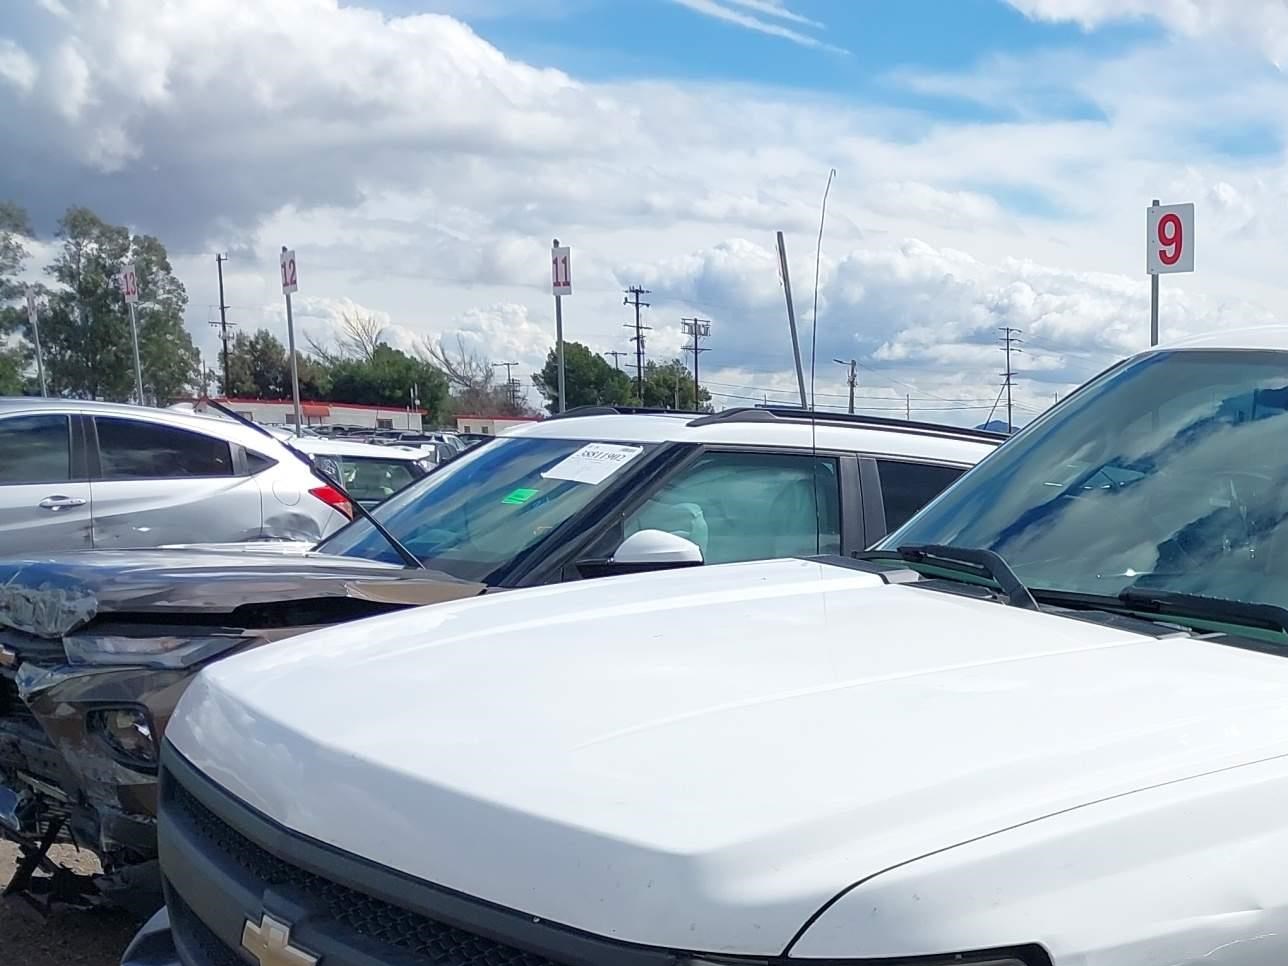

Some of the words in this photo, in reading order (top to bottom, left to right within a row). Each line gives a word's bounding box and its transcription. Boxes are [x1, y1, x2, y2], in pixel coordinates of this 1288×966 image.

[1156, 212, 1184, 266] 9
[123, 271, 136, 296] 13
[281, 258, 297, 287] 12
[552, 255, 570, 287] 11
